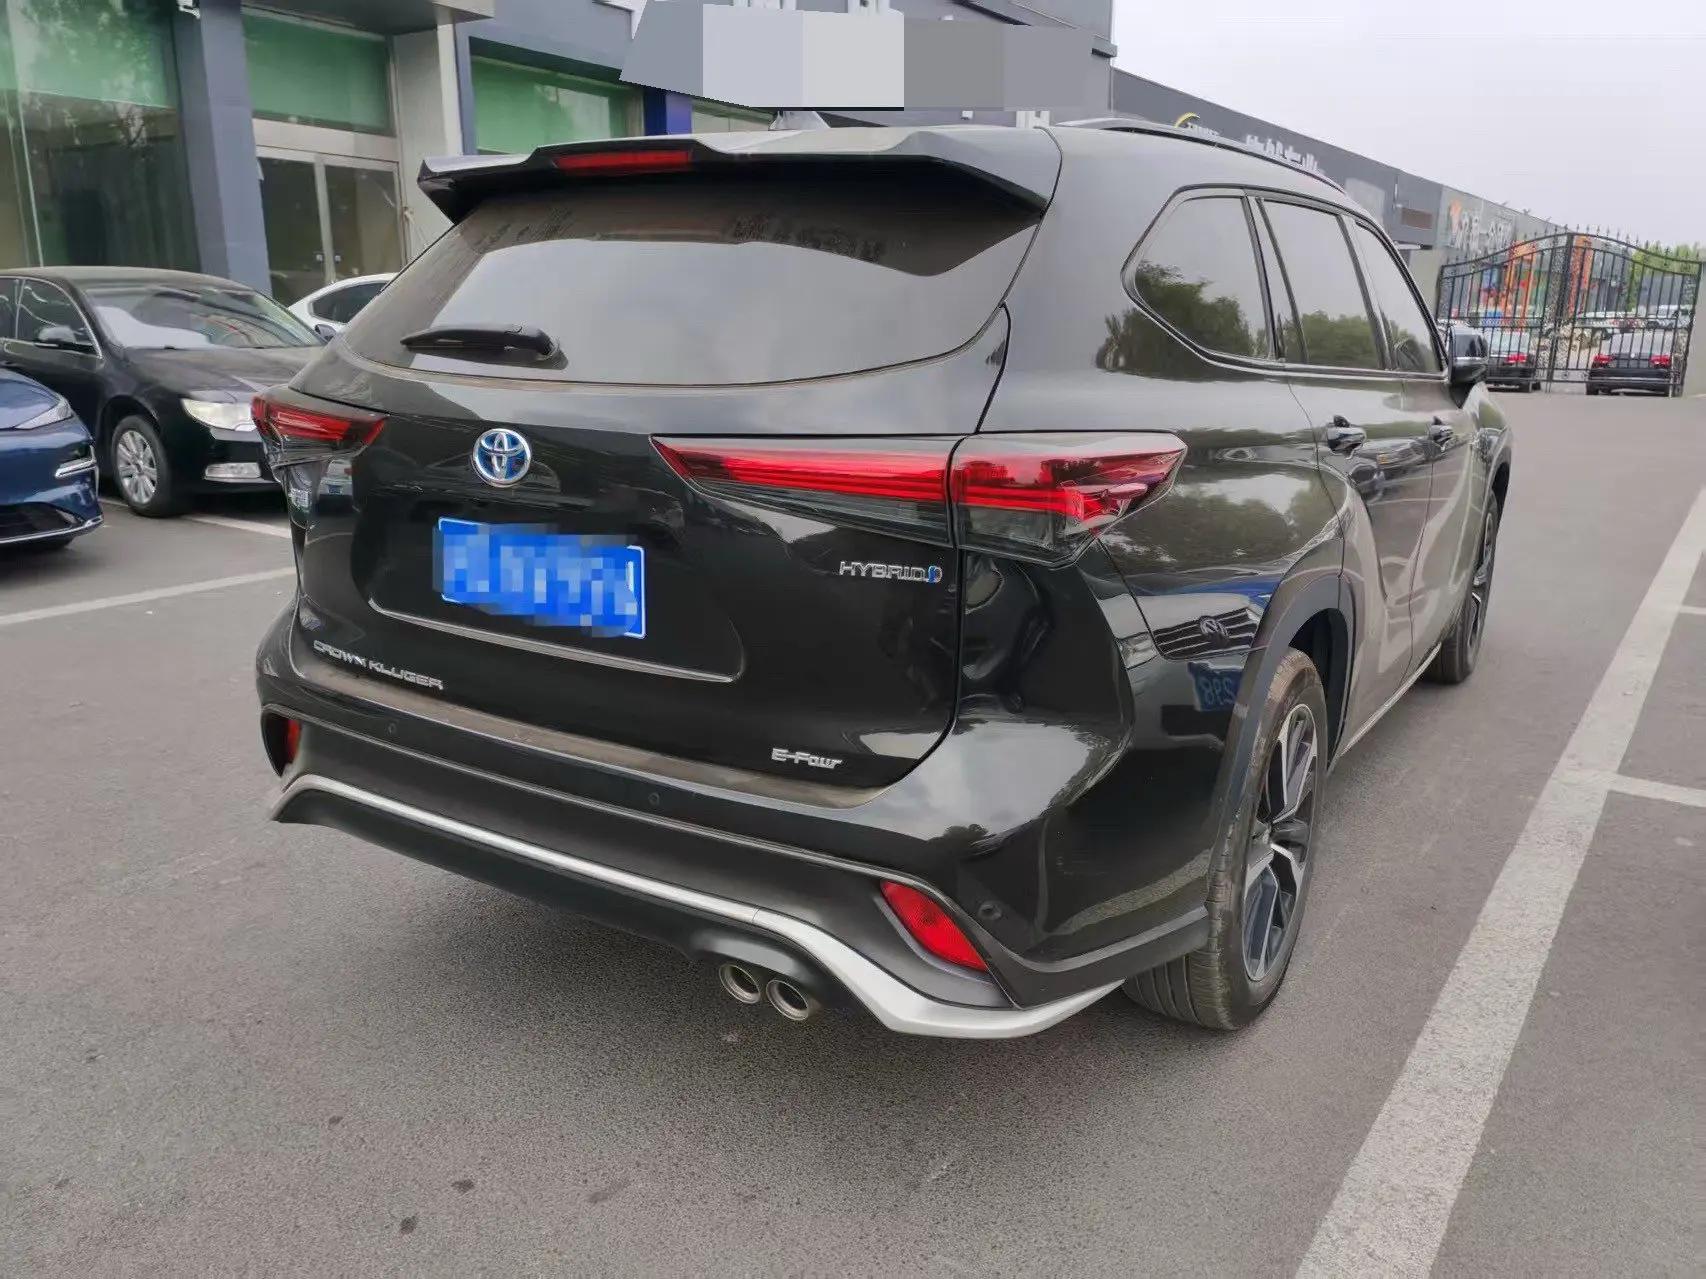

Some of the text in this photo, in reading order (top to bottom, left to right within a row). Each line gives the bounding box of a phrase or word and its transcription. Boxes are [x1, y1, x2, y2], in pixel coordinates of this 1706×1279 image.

[839, 561, 926, 583] HYBRID
[313, 639, 443, 690] CROWN KLUGER
[771, 747, 843, 770] E-Four
